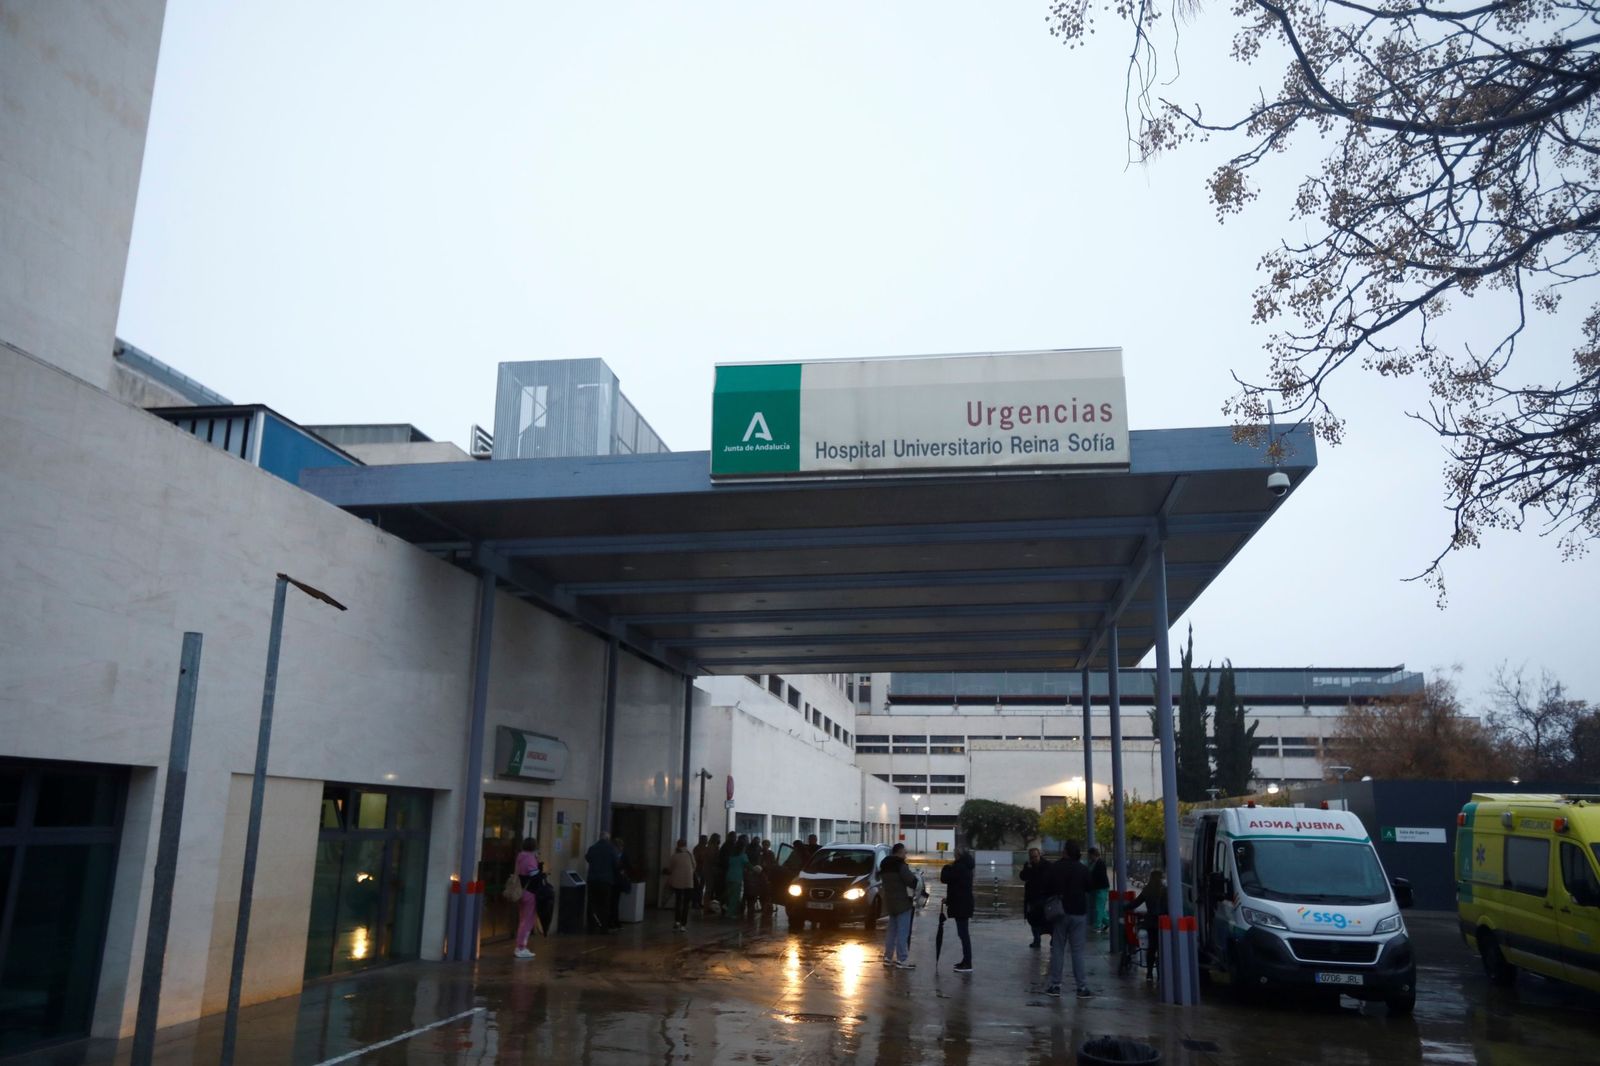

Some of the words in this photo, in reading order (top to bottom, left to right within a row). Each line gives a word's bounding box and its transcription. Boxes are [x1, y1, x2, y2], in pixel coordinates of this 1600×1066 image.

[967, 398, 1113, 430] Urgencias
[755, 442, 791, 451] Andalucía
[815, 440, 886, 462] Hospital
[894, 436, 1003, 458] Universitario
[1010, 435, 1060, 455] Reina
[1068, 432, 1115, 452] Sofía
[1313, 911, 1347, 929] ssg
